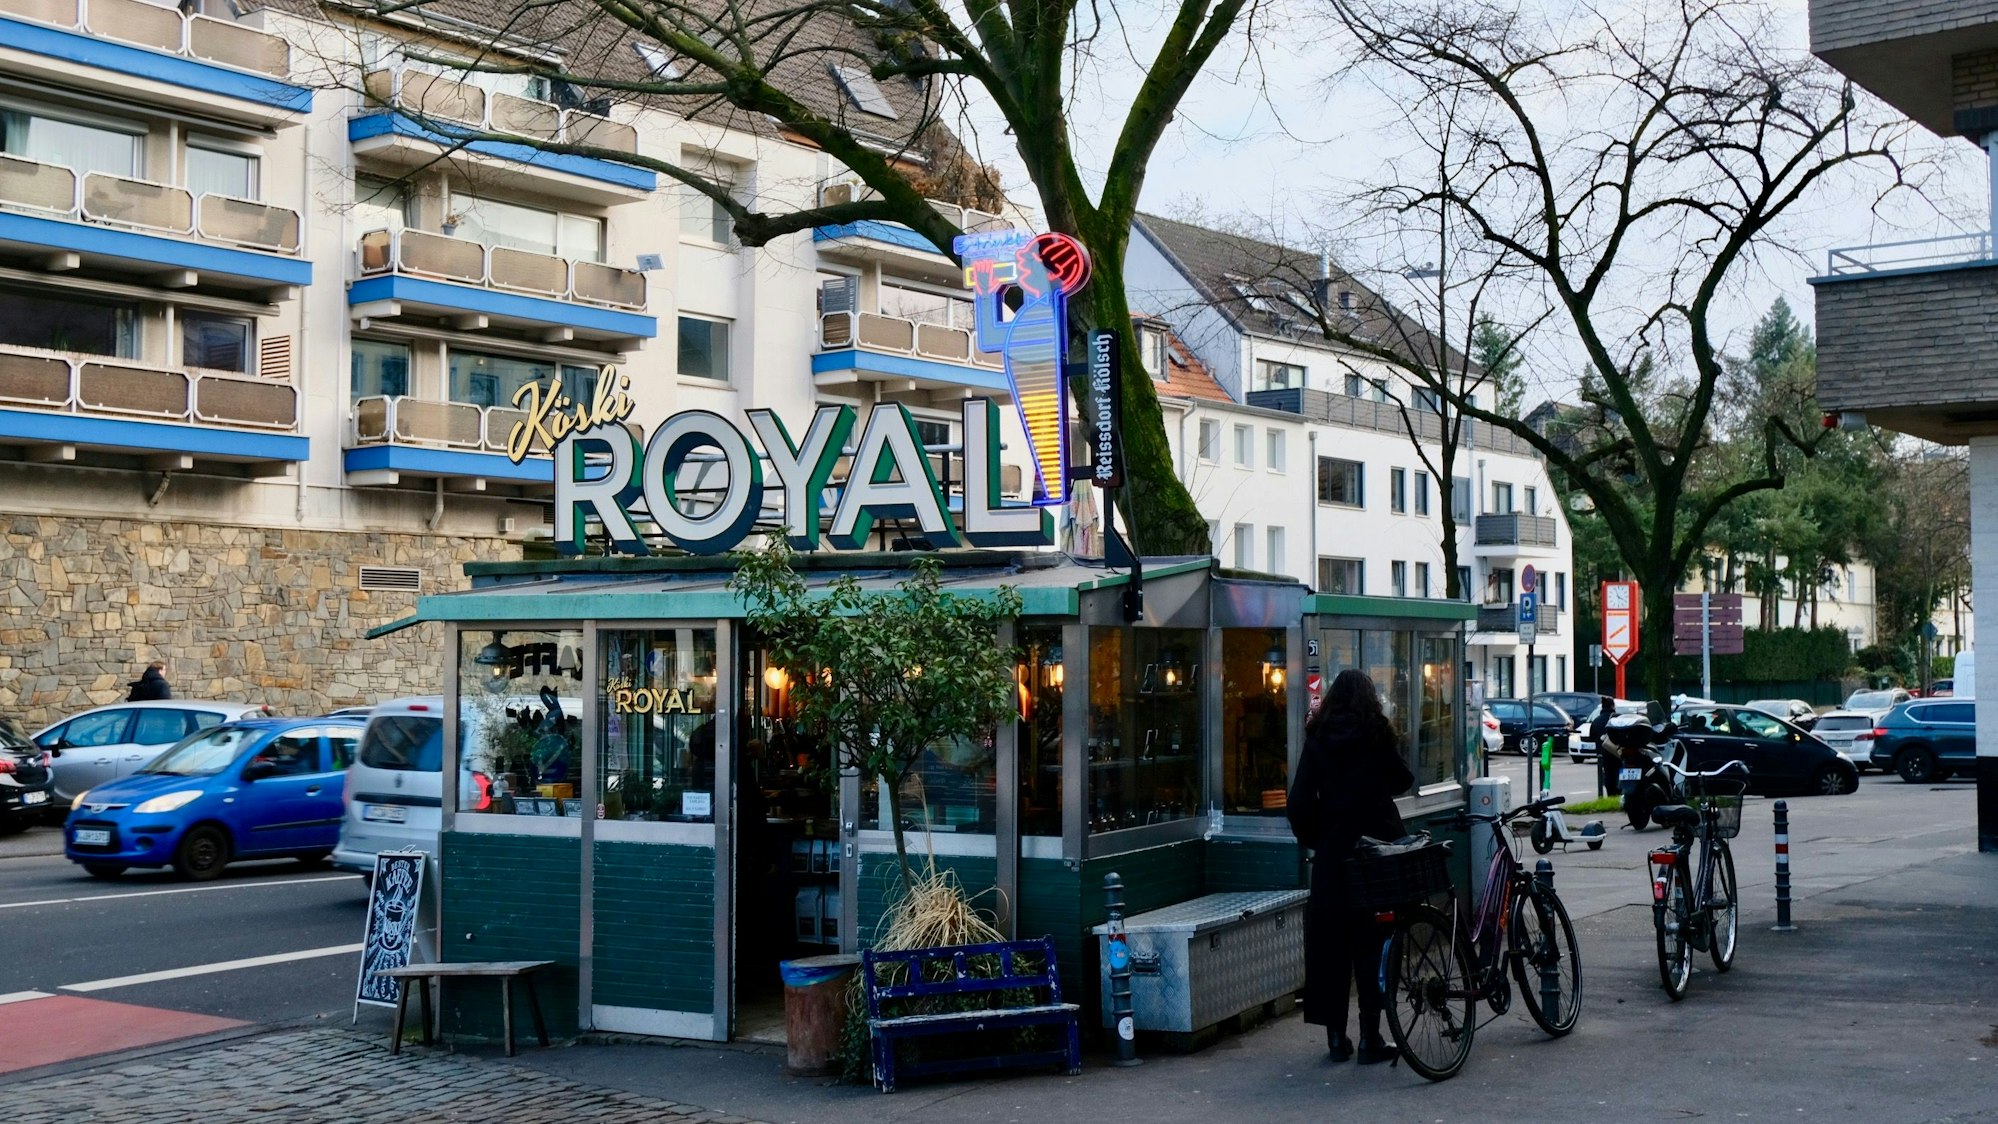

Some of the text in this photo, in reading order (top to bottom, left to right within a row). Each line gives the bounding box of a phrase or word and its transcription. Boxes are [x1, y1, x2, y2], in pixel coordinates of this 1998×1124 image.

[507, 363, 635, 464] Köski
[1092, 333, 1113, 482] Reissdorf Kölsch
[554, 397, 1052, 552] ROYAL
[607, 677, 633, 693] Köski
[615, 688, 701, 714] ROYAL
